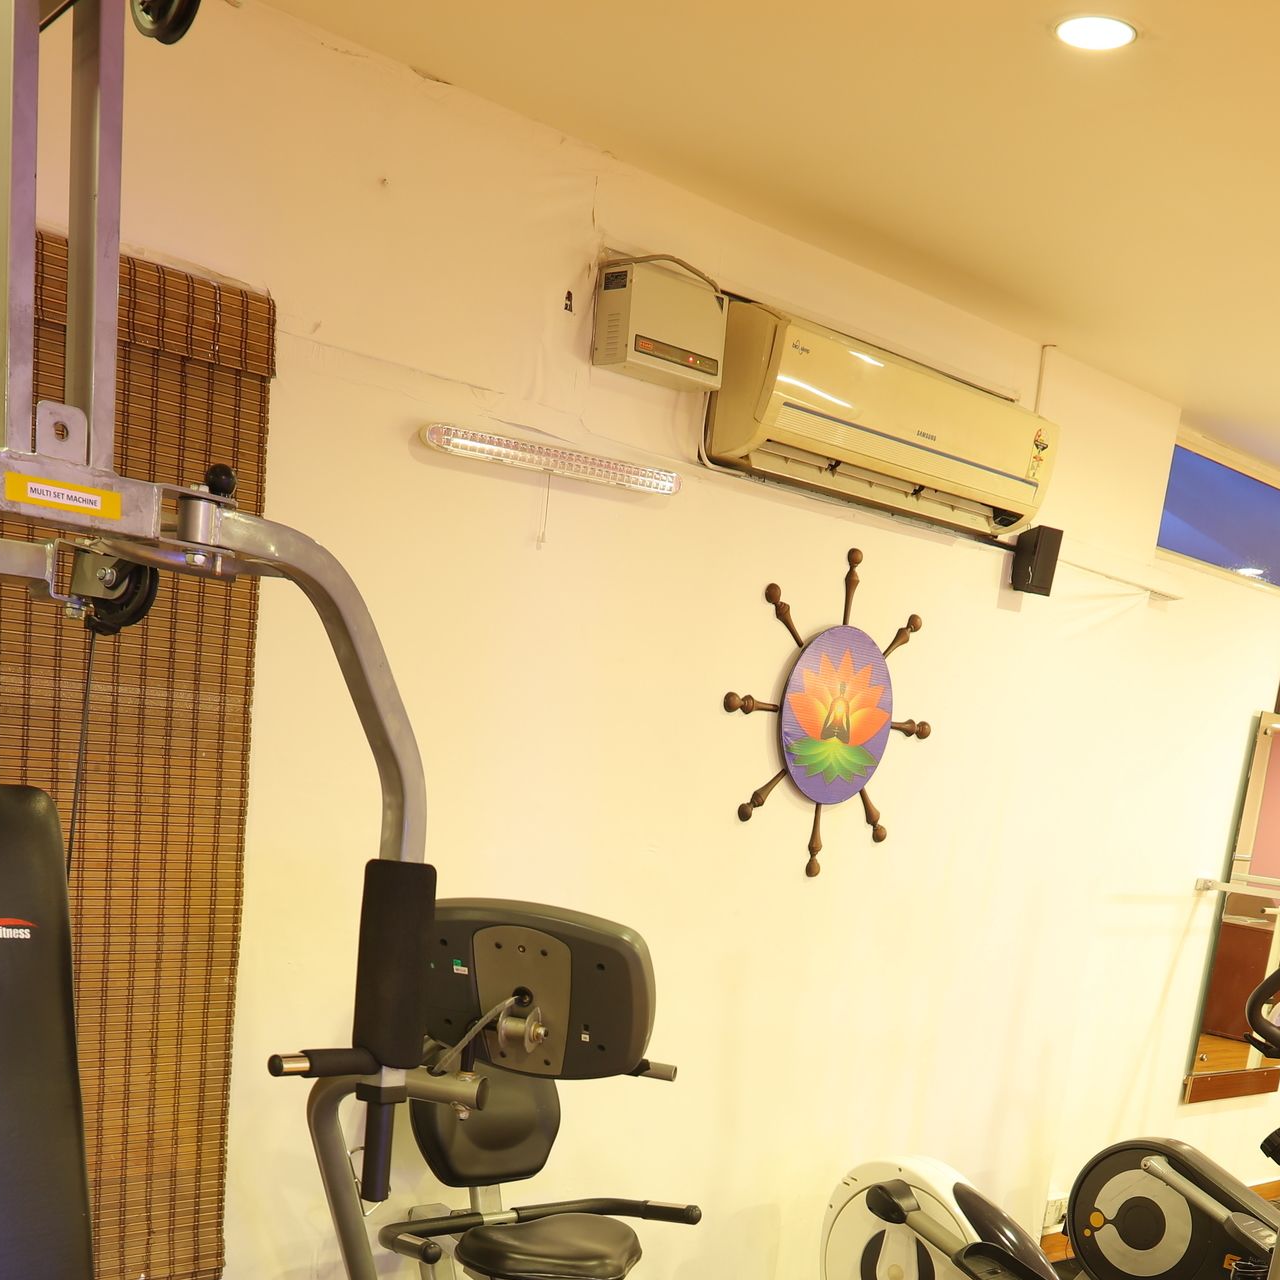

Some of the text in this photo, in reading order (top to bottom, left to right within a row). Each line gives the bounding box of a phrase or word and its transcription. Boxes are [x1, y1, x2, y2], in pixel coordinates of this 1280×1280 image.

[29, 486, 98, 507] MULTI SET MACHINE
